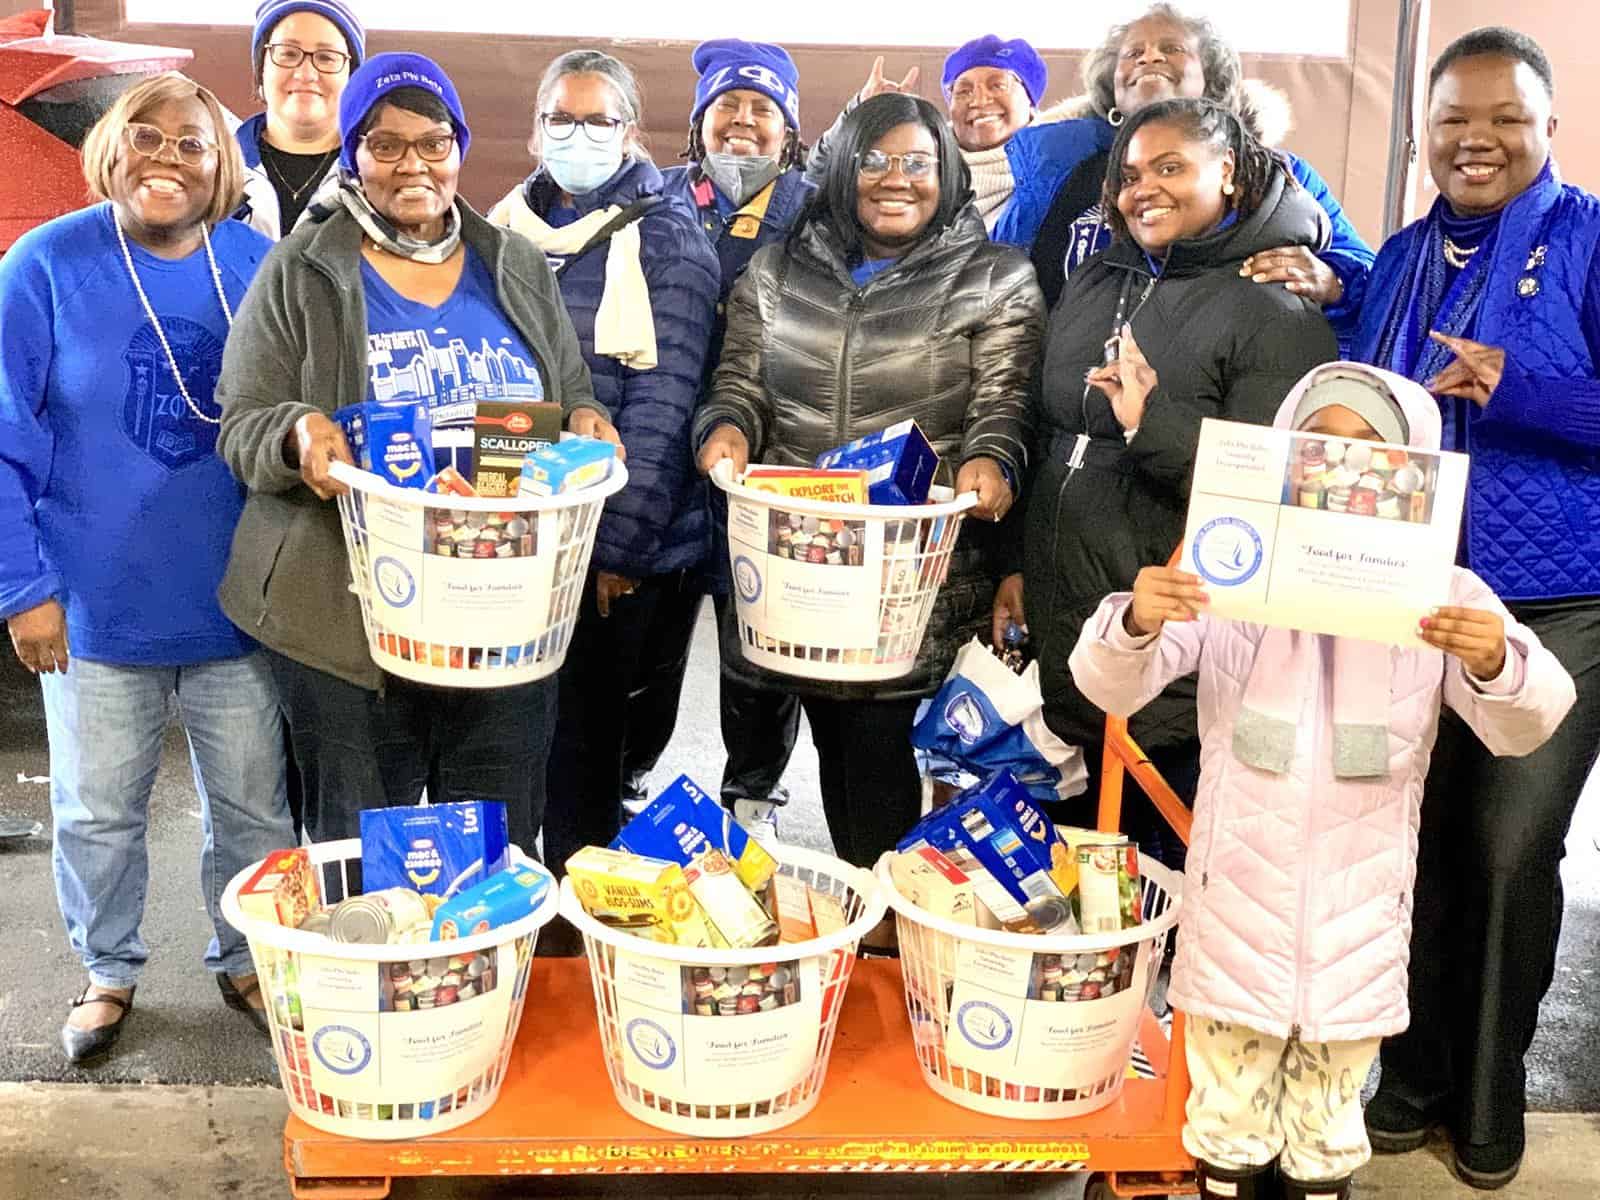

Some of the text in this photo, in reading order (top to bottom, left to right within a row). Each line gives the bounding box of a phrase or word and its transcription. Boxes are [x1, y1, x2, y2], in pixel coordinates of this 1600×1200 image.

[375, 71, 443, 95] Zeta Phi Beta
[789, 483, 834, 498] EXPLORE
[464, 807, 478, 827] 5
[407, 850, 431, 861] mac
[606, 884, 641, 897] VANILLA
